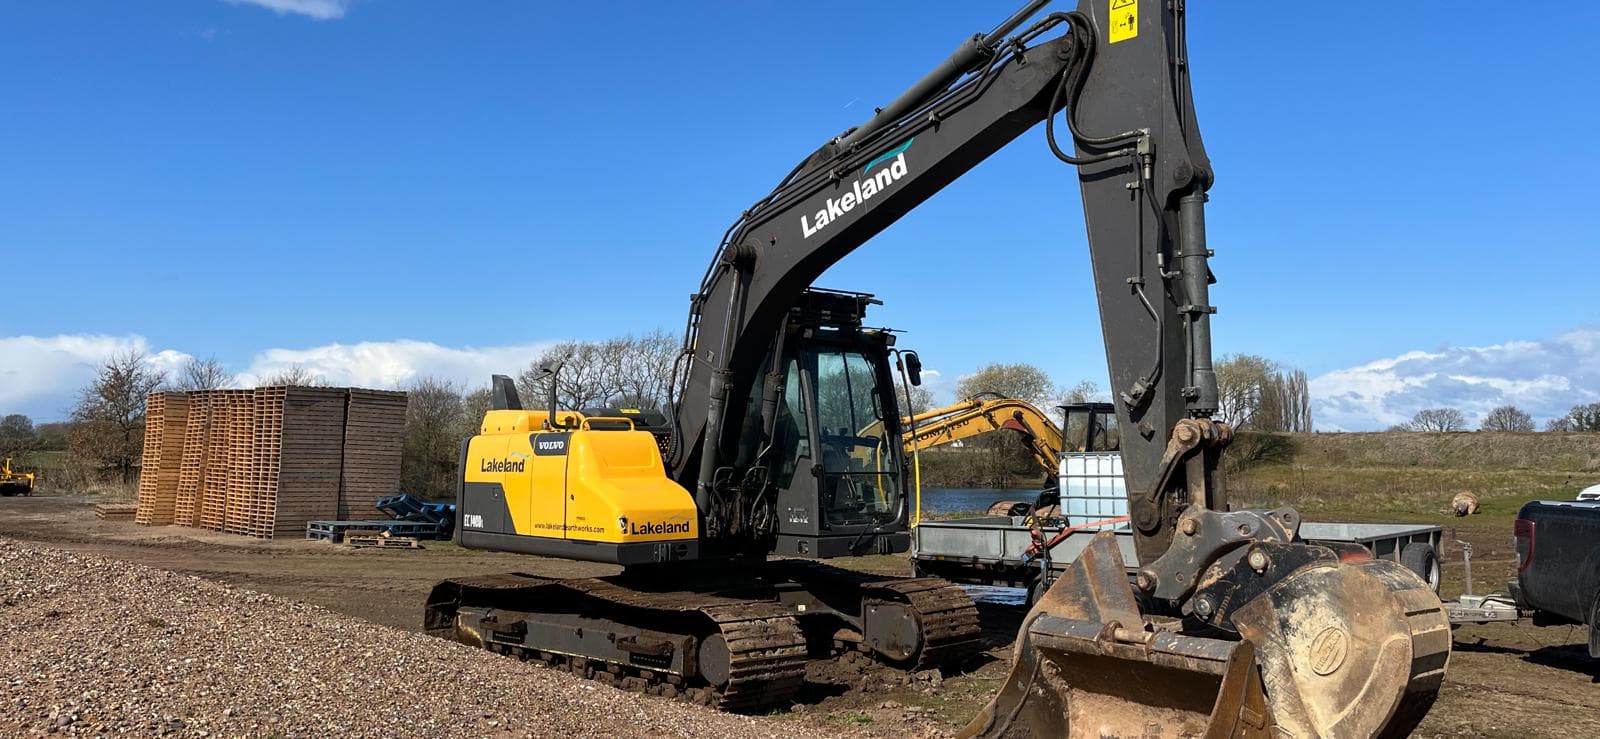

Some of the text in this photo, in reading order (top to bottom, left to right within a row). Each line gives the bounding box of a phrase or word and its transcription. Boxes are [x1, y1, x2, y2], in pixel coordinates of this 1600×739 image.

[801, 153, 908, 239] Lakeland
[539, 440, 565, 450] VOLVO
[481, 457, 525, 473] Lakeland
[631, 521, 690, 535] Lakeland
